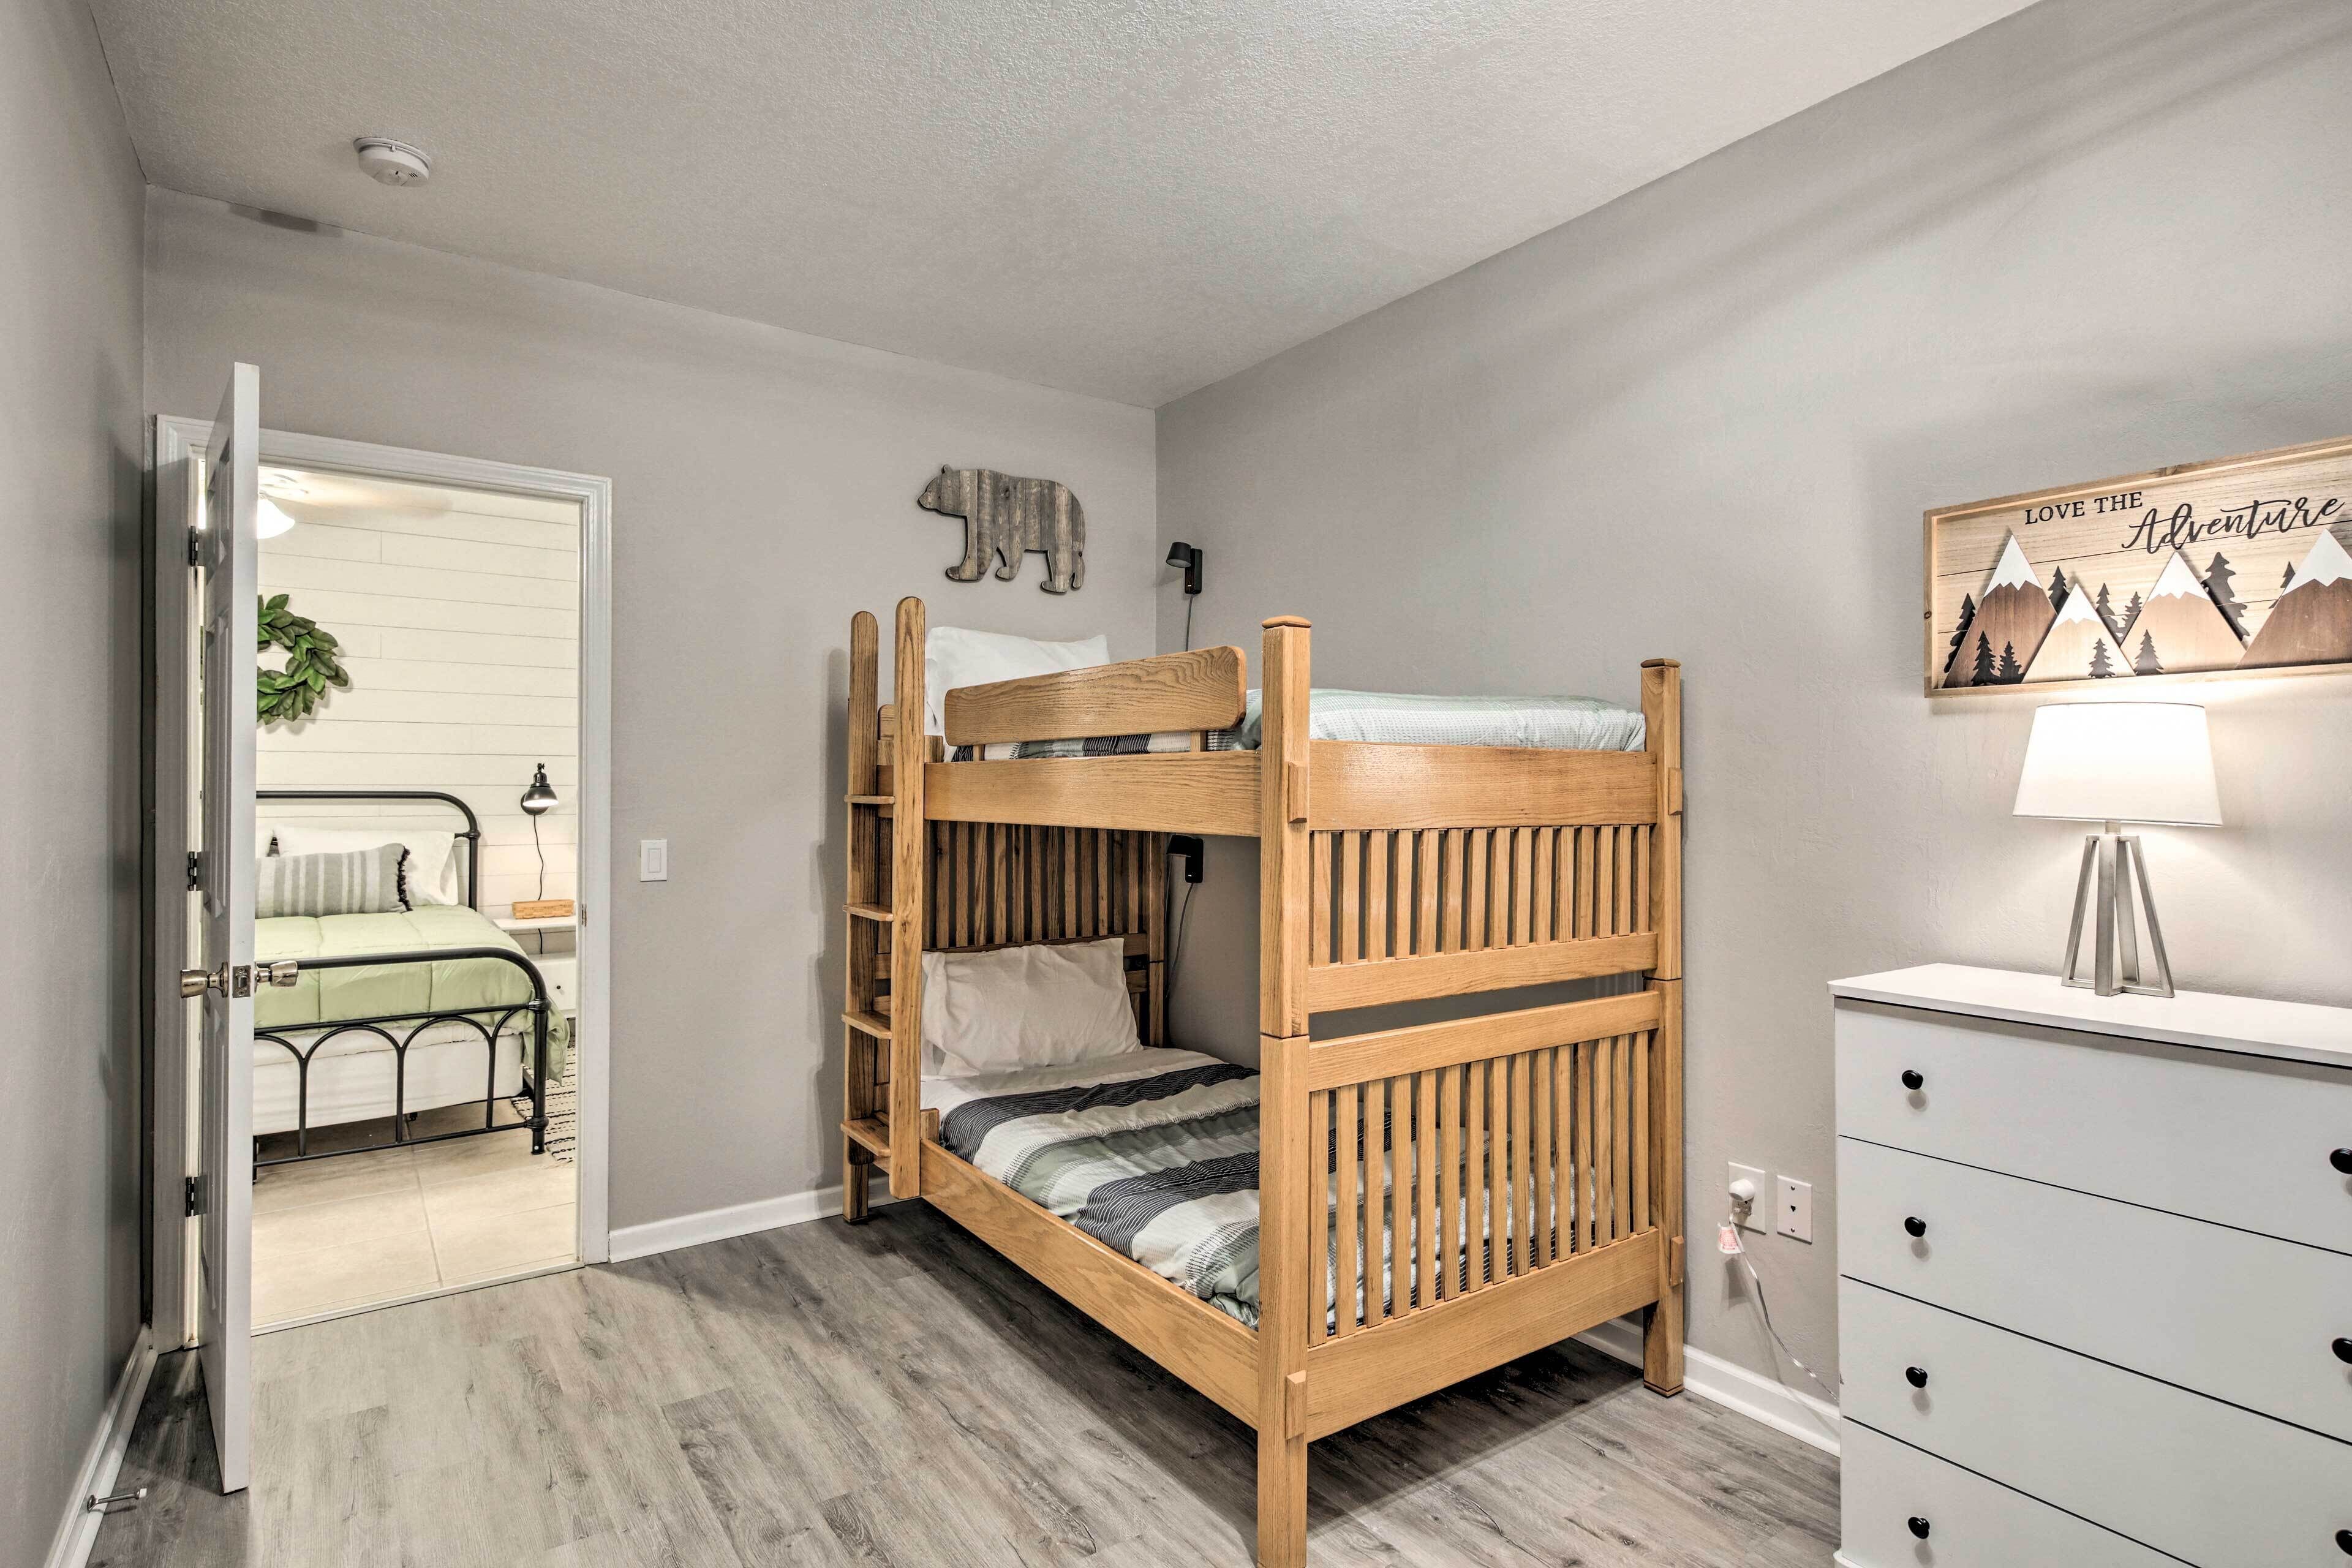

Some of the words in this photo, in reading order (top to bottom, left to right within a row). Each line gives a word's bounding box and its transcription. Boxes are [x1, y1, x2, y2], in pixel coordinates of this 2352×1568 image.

[2025, 501, 2085, 524] LOVE
[2094, 492, 2143, 513] THE
[2121, 496, 2344, 554] Adventure
